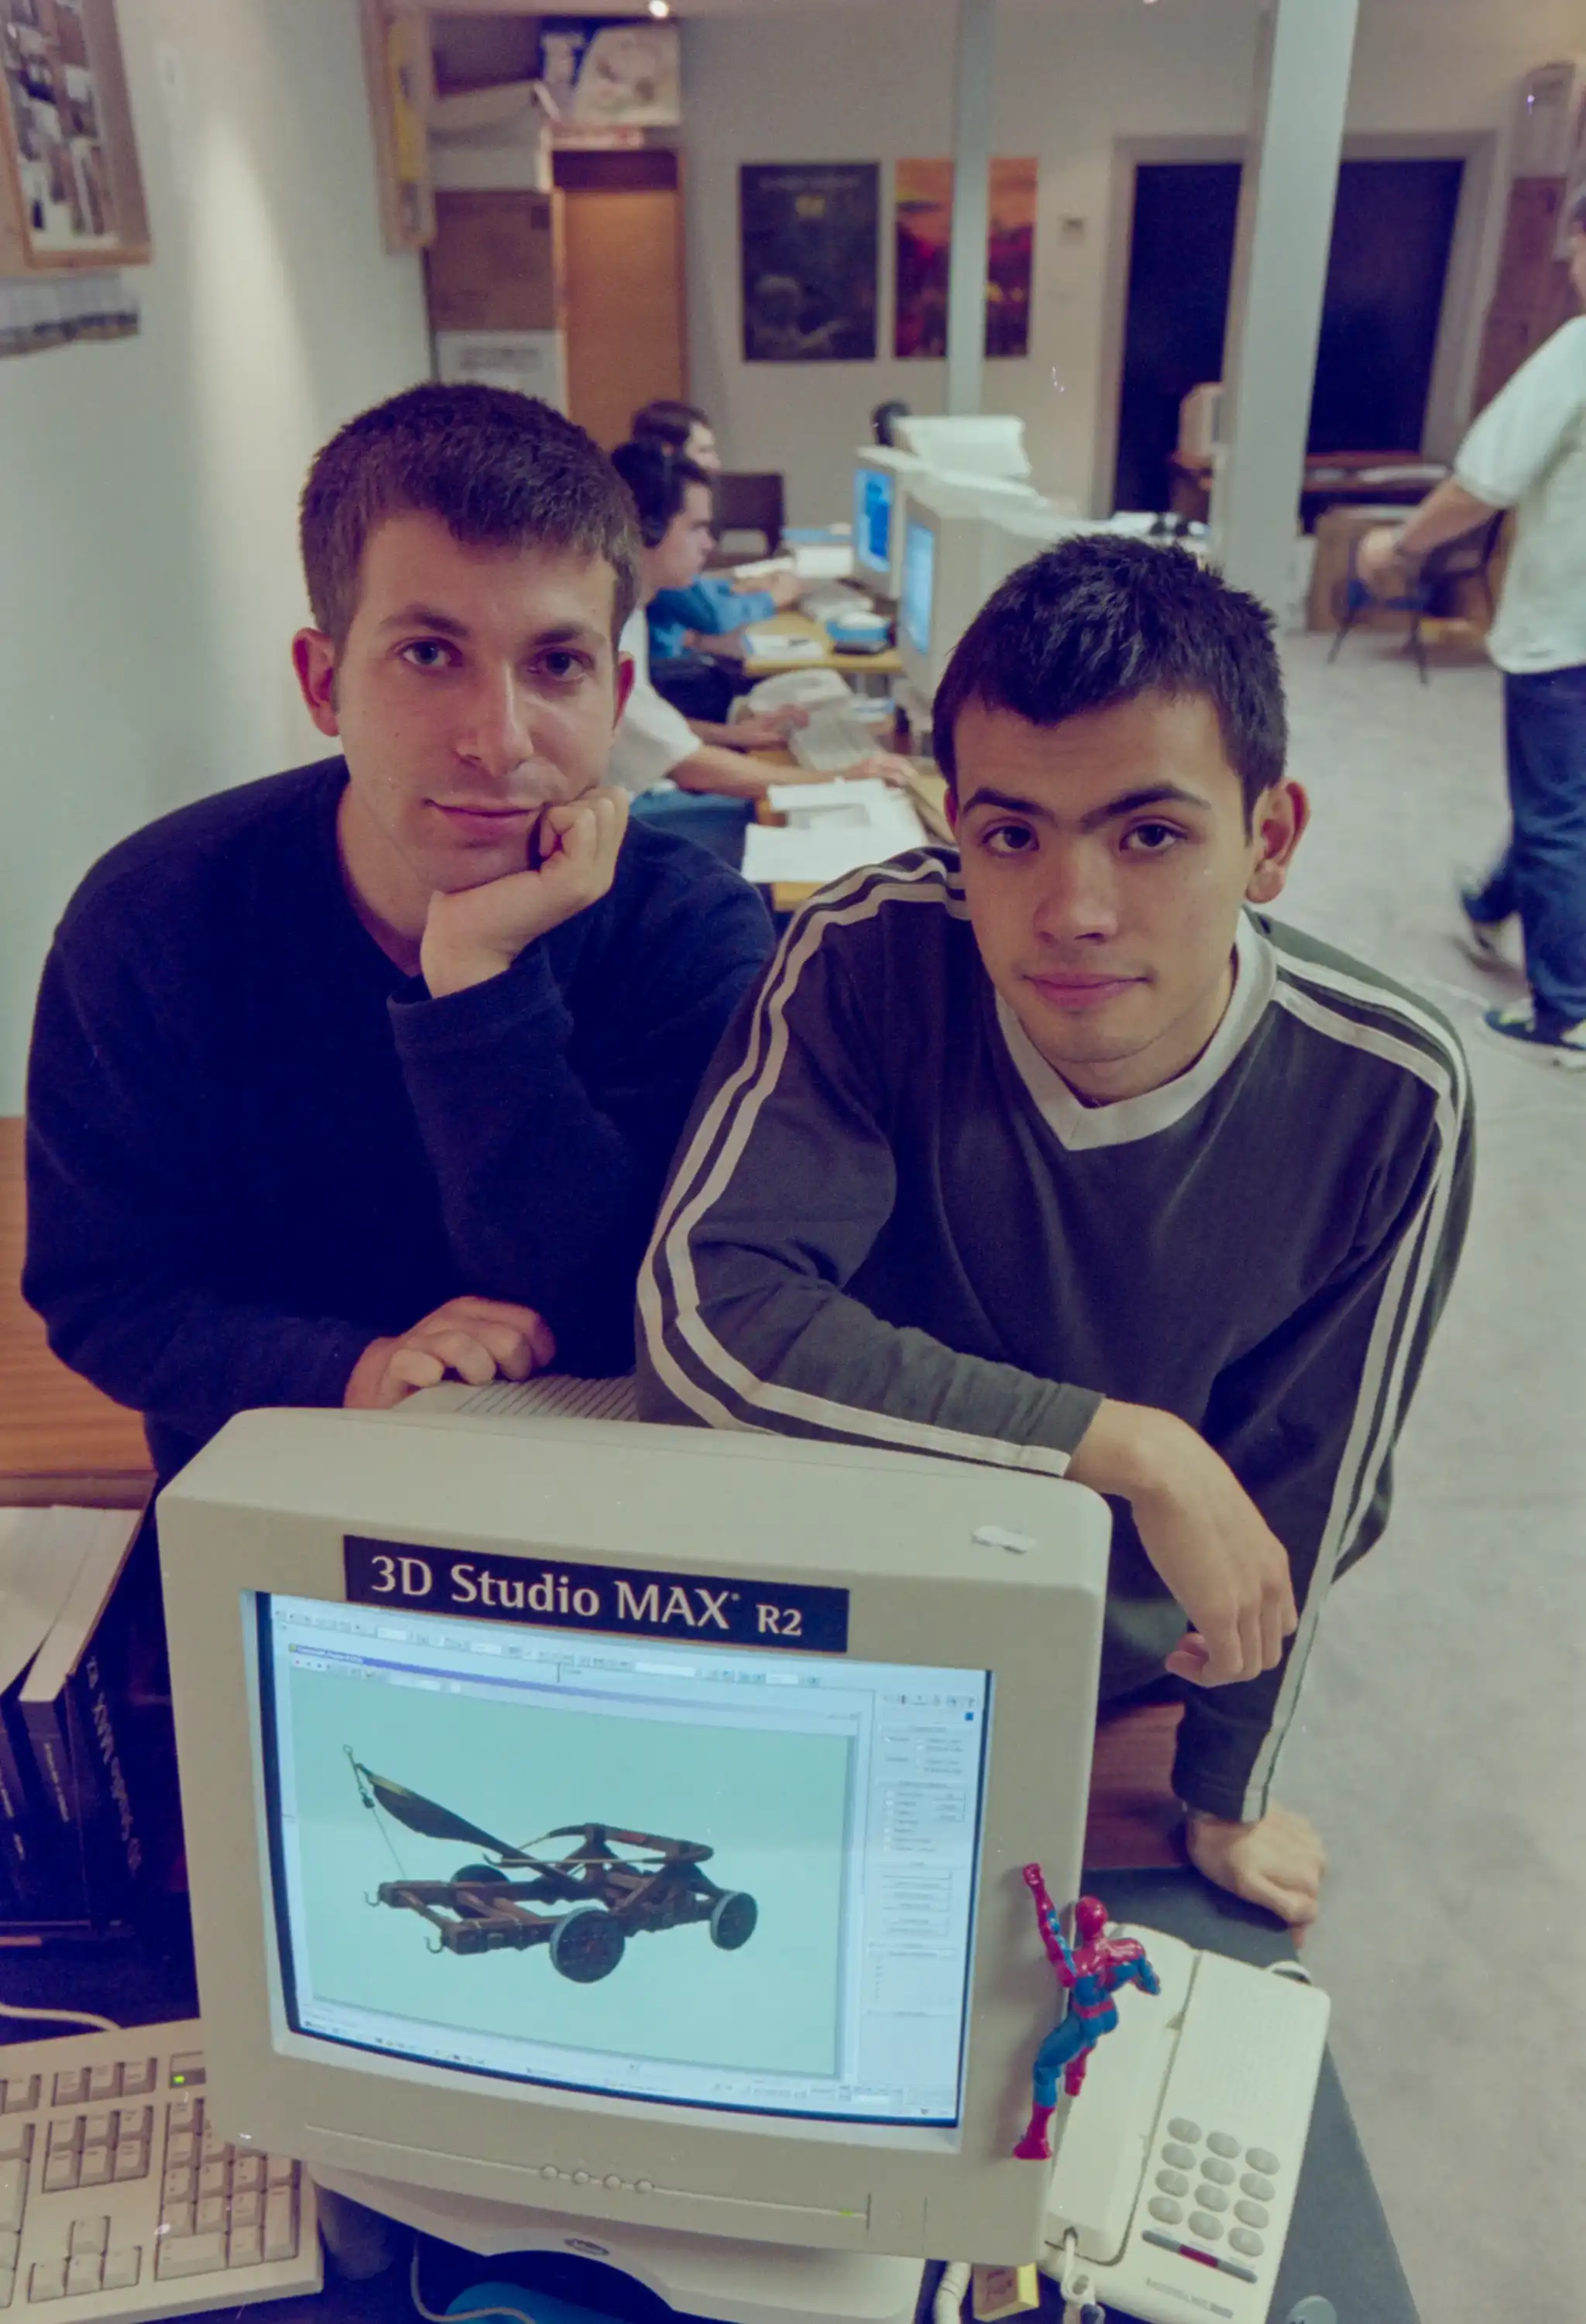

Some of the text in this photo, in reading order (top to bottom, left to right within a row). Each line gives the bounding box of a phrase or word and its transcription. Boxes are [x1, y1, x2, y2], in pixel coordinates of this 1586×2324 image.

[372, 1556, 432, 1596] 3D
[451, 1564, 600, 1616] Studio
[756, 1605, 802, 1636] R2
